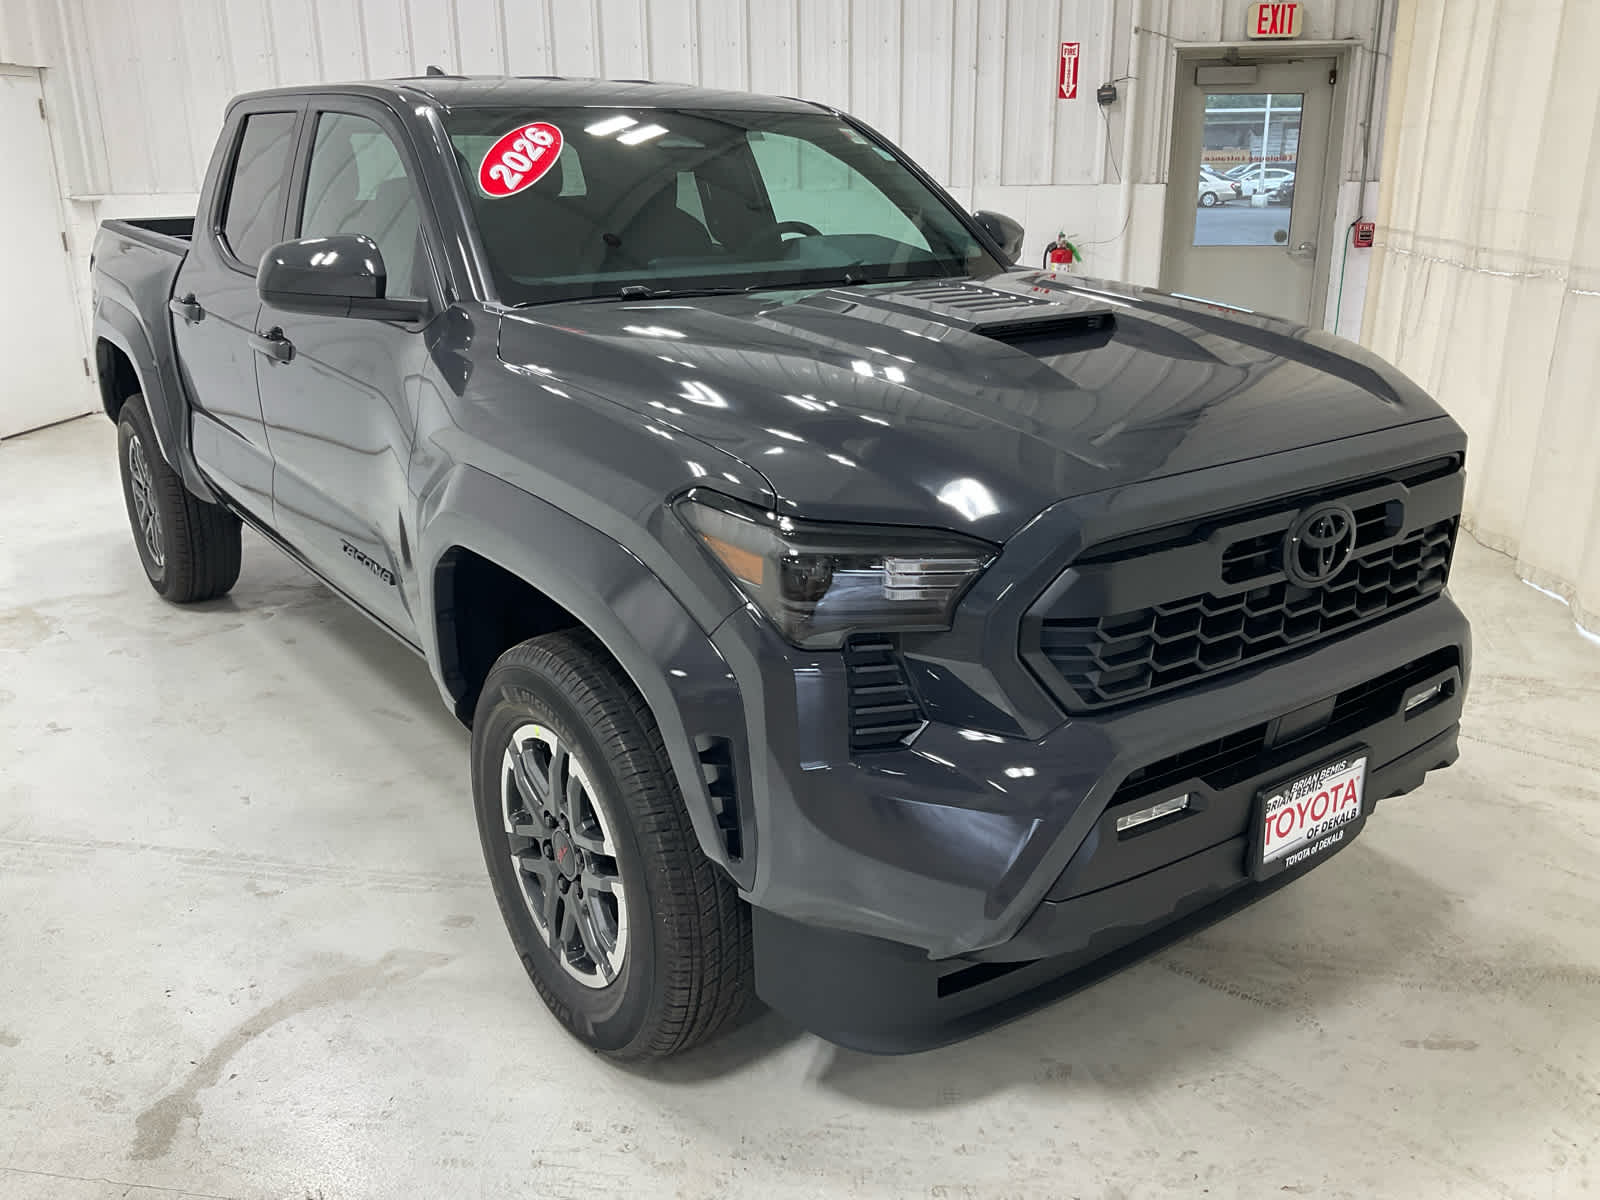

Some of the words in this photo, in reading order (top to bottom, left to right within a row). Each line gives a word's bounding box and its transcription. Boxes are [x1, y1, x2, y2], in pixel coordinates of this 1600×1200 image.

[1257, 4, 1297, 34] EXIT
[1063, 47, 1076, 56] FIRE
[489, 128, 554, 190] 2026
[340, 538, 395, 585] TACOMA
[1291, 772, 1320, 793] BRIAN
[1320, 760, 1347, 780] BEMIS
[1265, 778, 1357, 846] TOYOTA
[1266, 792, 1293, 814] BRIAN
[1306, 824, 1320, 840] OF
[1321, 807, 1357, 833] DEKALB
[1285, 849, 1310, 868] TOYOTA
[1311, 842, 1319, 854] of
[1319, 830, 1344, 850] DEKALB
